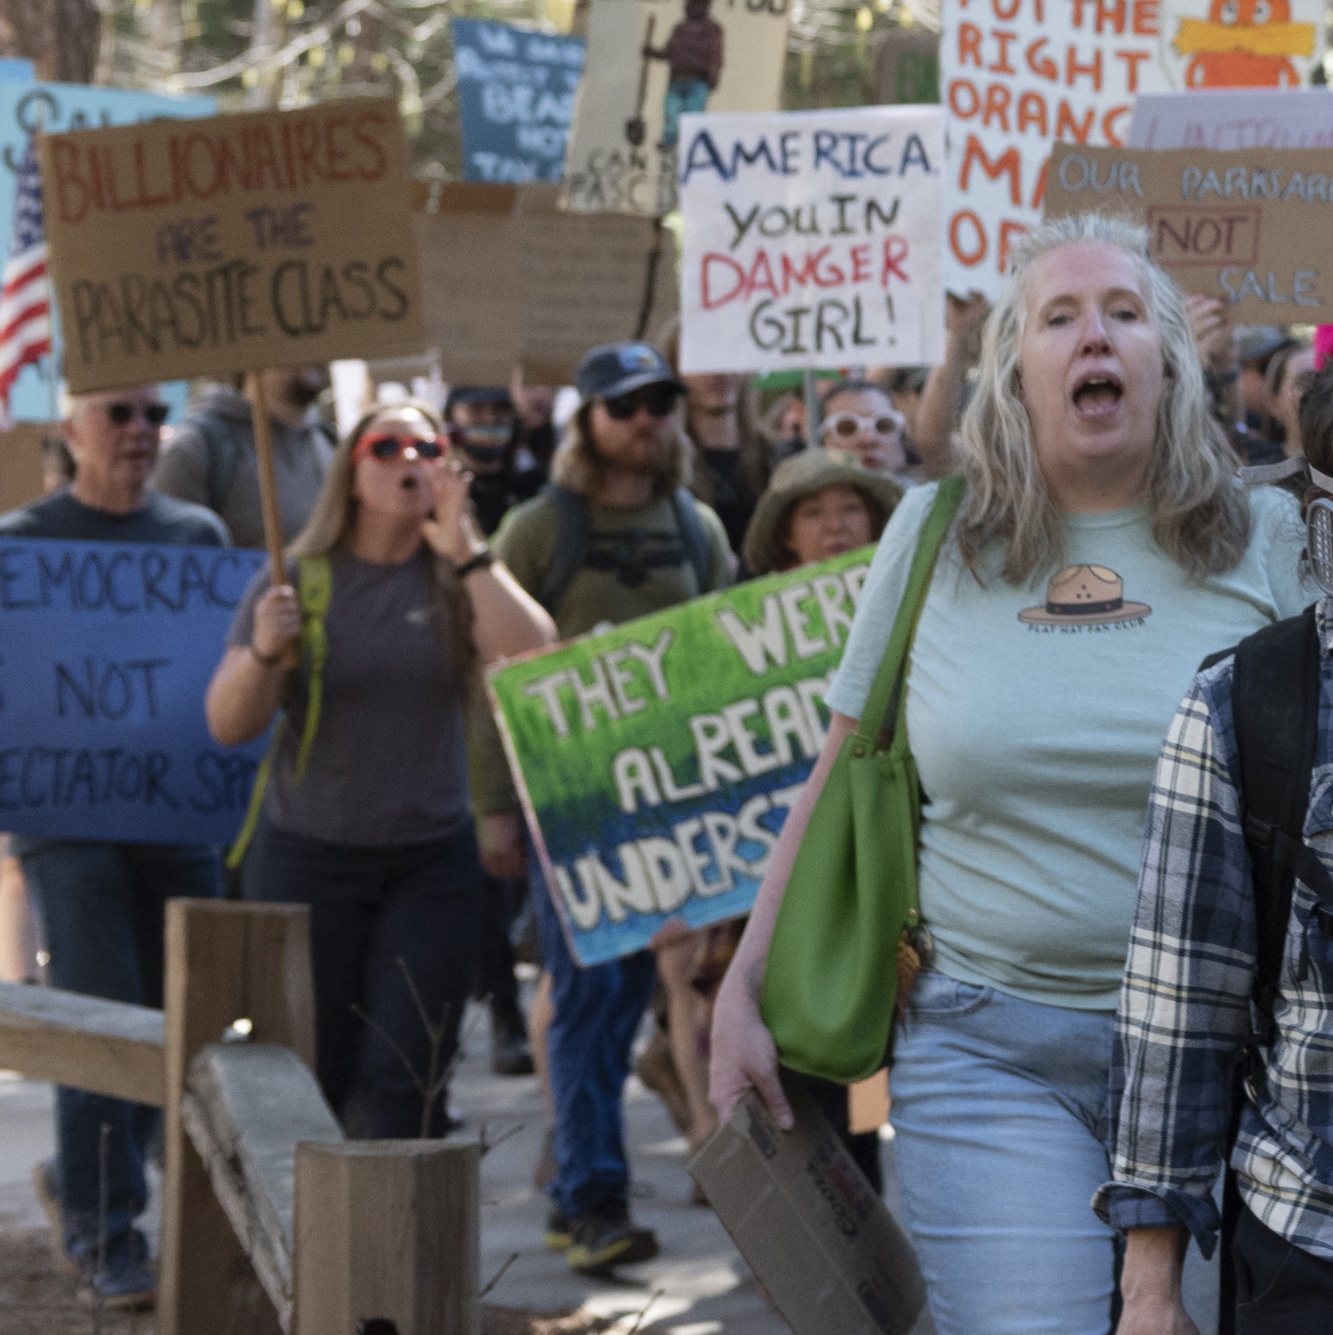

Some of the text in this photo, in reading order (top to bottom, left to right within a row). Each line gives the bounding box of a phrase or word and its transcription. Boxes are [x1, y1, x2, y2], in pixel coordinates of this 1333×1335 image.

[958, 21, 1151, 94] RIGHT
[52, 113, 389, 227] BILLIONAIRES
[1059, 153, 1143, 198] OUR
[154, 201, 317, 264] ARE THE
[829, 194, 899, 236] IN
[1155, 216, 1249, 255] NOT
[701, 234, 911, 311] DANGER
[1218, 267, 1323, 307] SALE
[72, 258, 270, 364] PARASITE
[271, 256, 411, 339] CLASS
[749, 292, 898, 355] GIRL!
[0, 546, 266, 614] EMOCRAC
[55, 657, 171, 719] NOT
[524, 625, 677, 740] THEY
